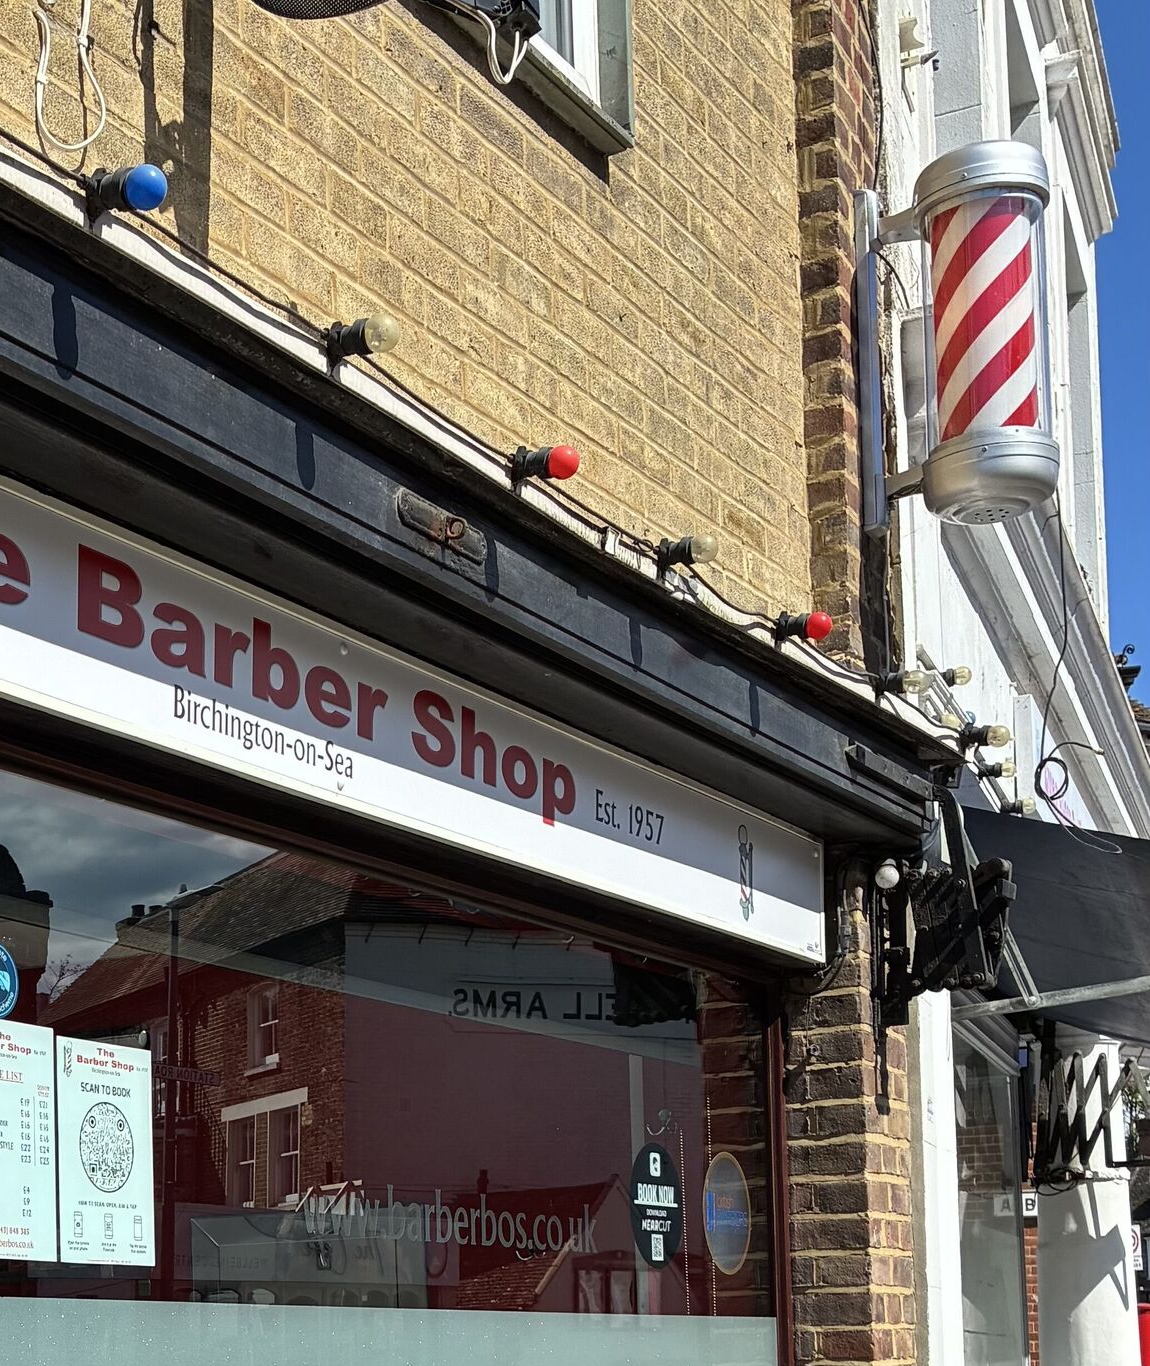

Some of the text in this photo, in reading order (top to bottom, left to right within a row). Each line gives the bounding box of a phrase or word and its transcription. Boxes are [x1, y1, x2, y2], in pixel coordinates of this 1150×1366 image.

[77, 543, 389, 741] Barber
[412, 689, 576, 826] Shop
[173, 684, 353, 779] Birchington-on-Sea
[595, 789, 664, 845] Est. 1957
[8, 1043, 32, 1055] Shop
[97, 1047, 115, 1058] The
[76, 1054, 109, 1067] Barber
[111, 1060, 134, 1072] Shop
[5, 1070, 23, 1082] LIST
[80, 1082, 131, 1098] SCAN TO BOOK
[637, 1183, 675, 1204] BOOK NOW
[303, 1184, 598, 1253] www.barberbos.co.uk
